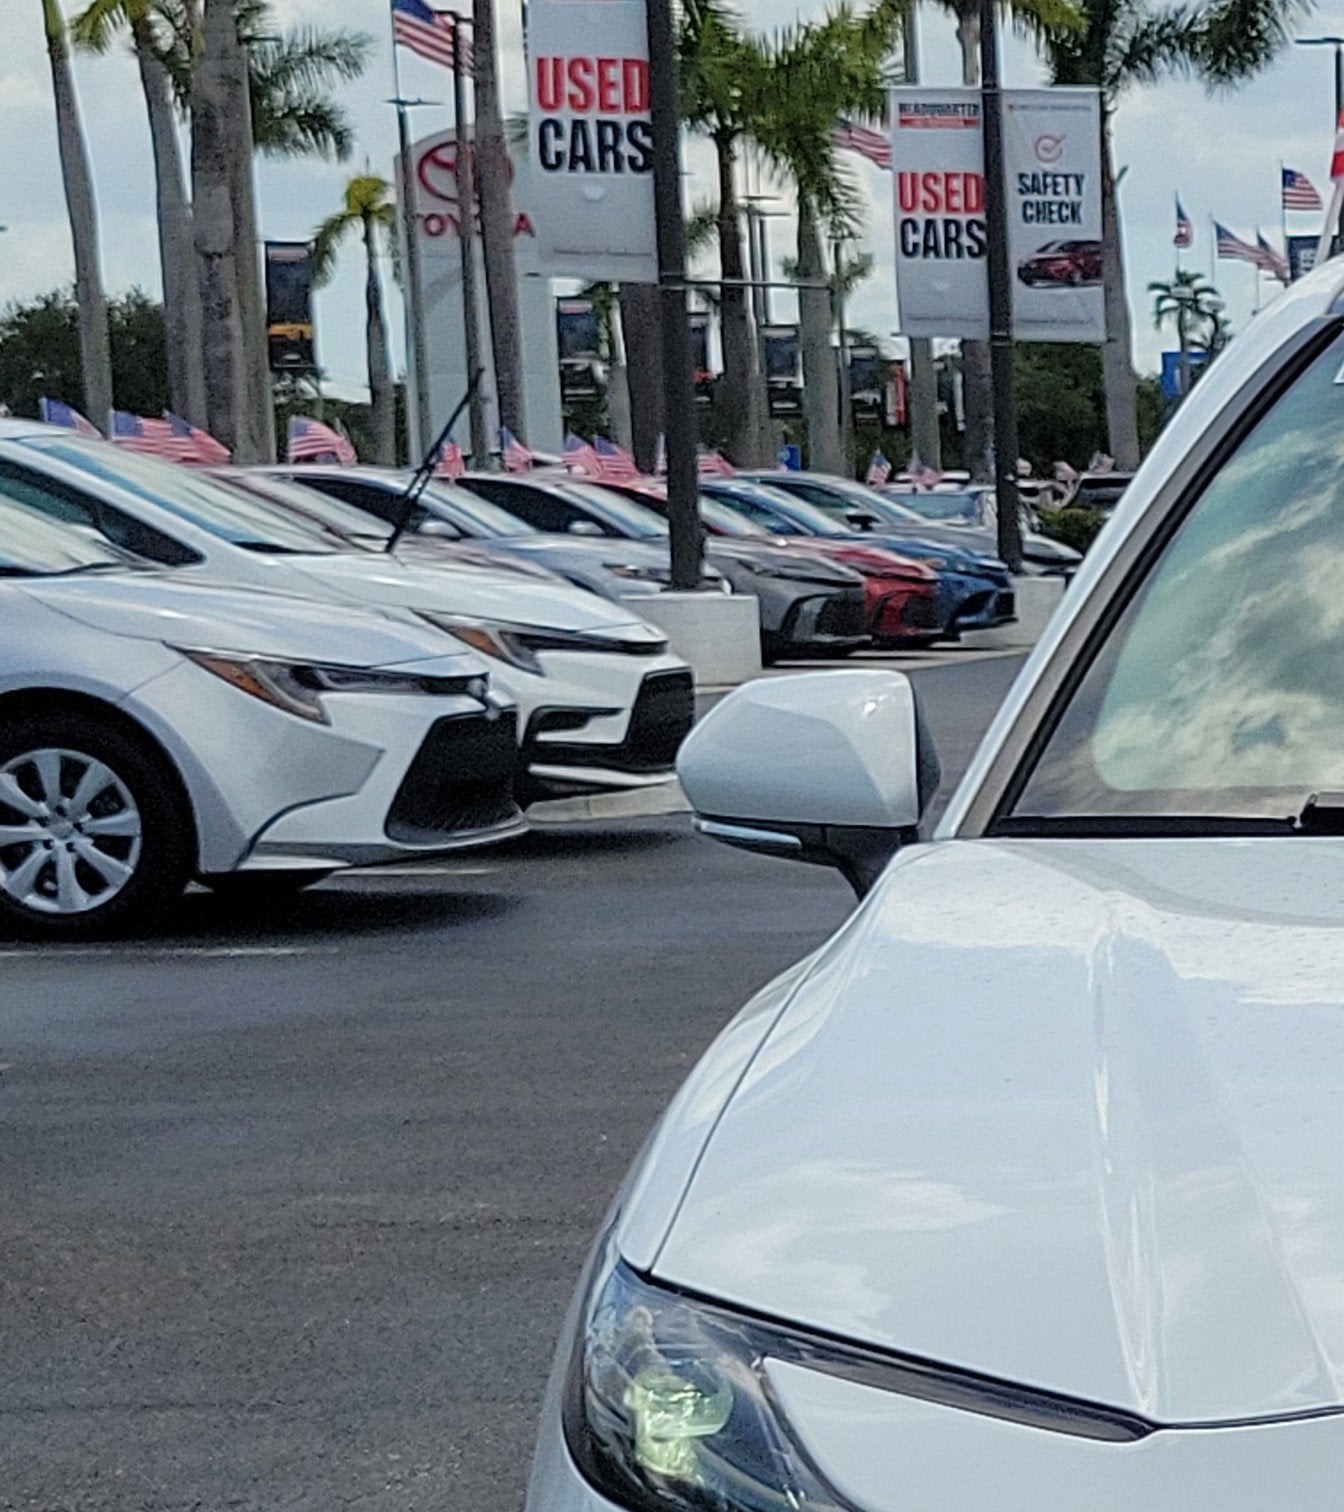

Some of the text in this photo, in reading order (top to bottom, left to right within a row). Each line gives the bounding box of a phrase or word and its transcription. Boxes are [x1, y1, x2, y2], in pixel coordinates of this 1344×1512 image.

[536, 56, 650, 113] USED
[538, 118, 654, 173] CARS
[898, 171, 984, 214] USED
[1017, 172, 1085, 197] SAFETY
[1022, 200, 1083, 225] CHECK
[901, 218, 987, 260] CARS
